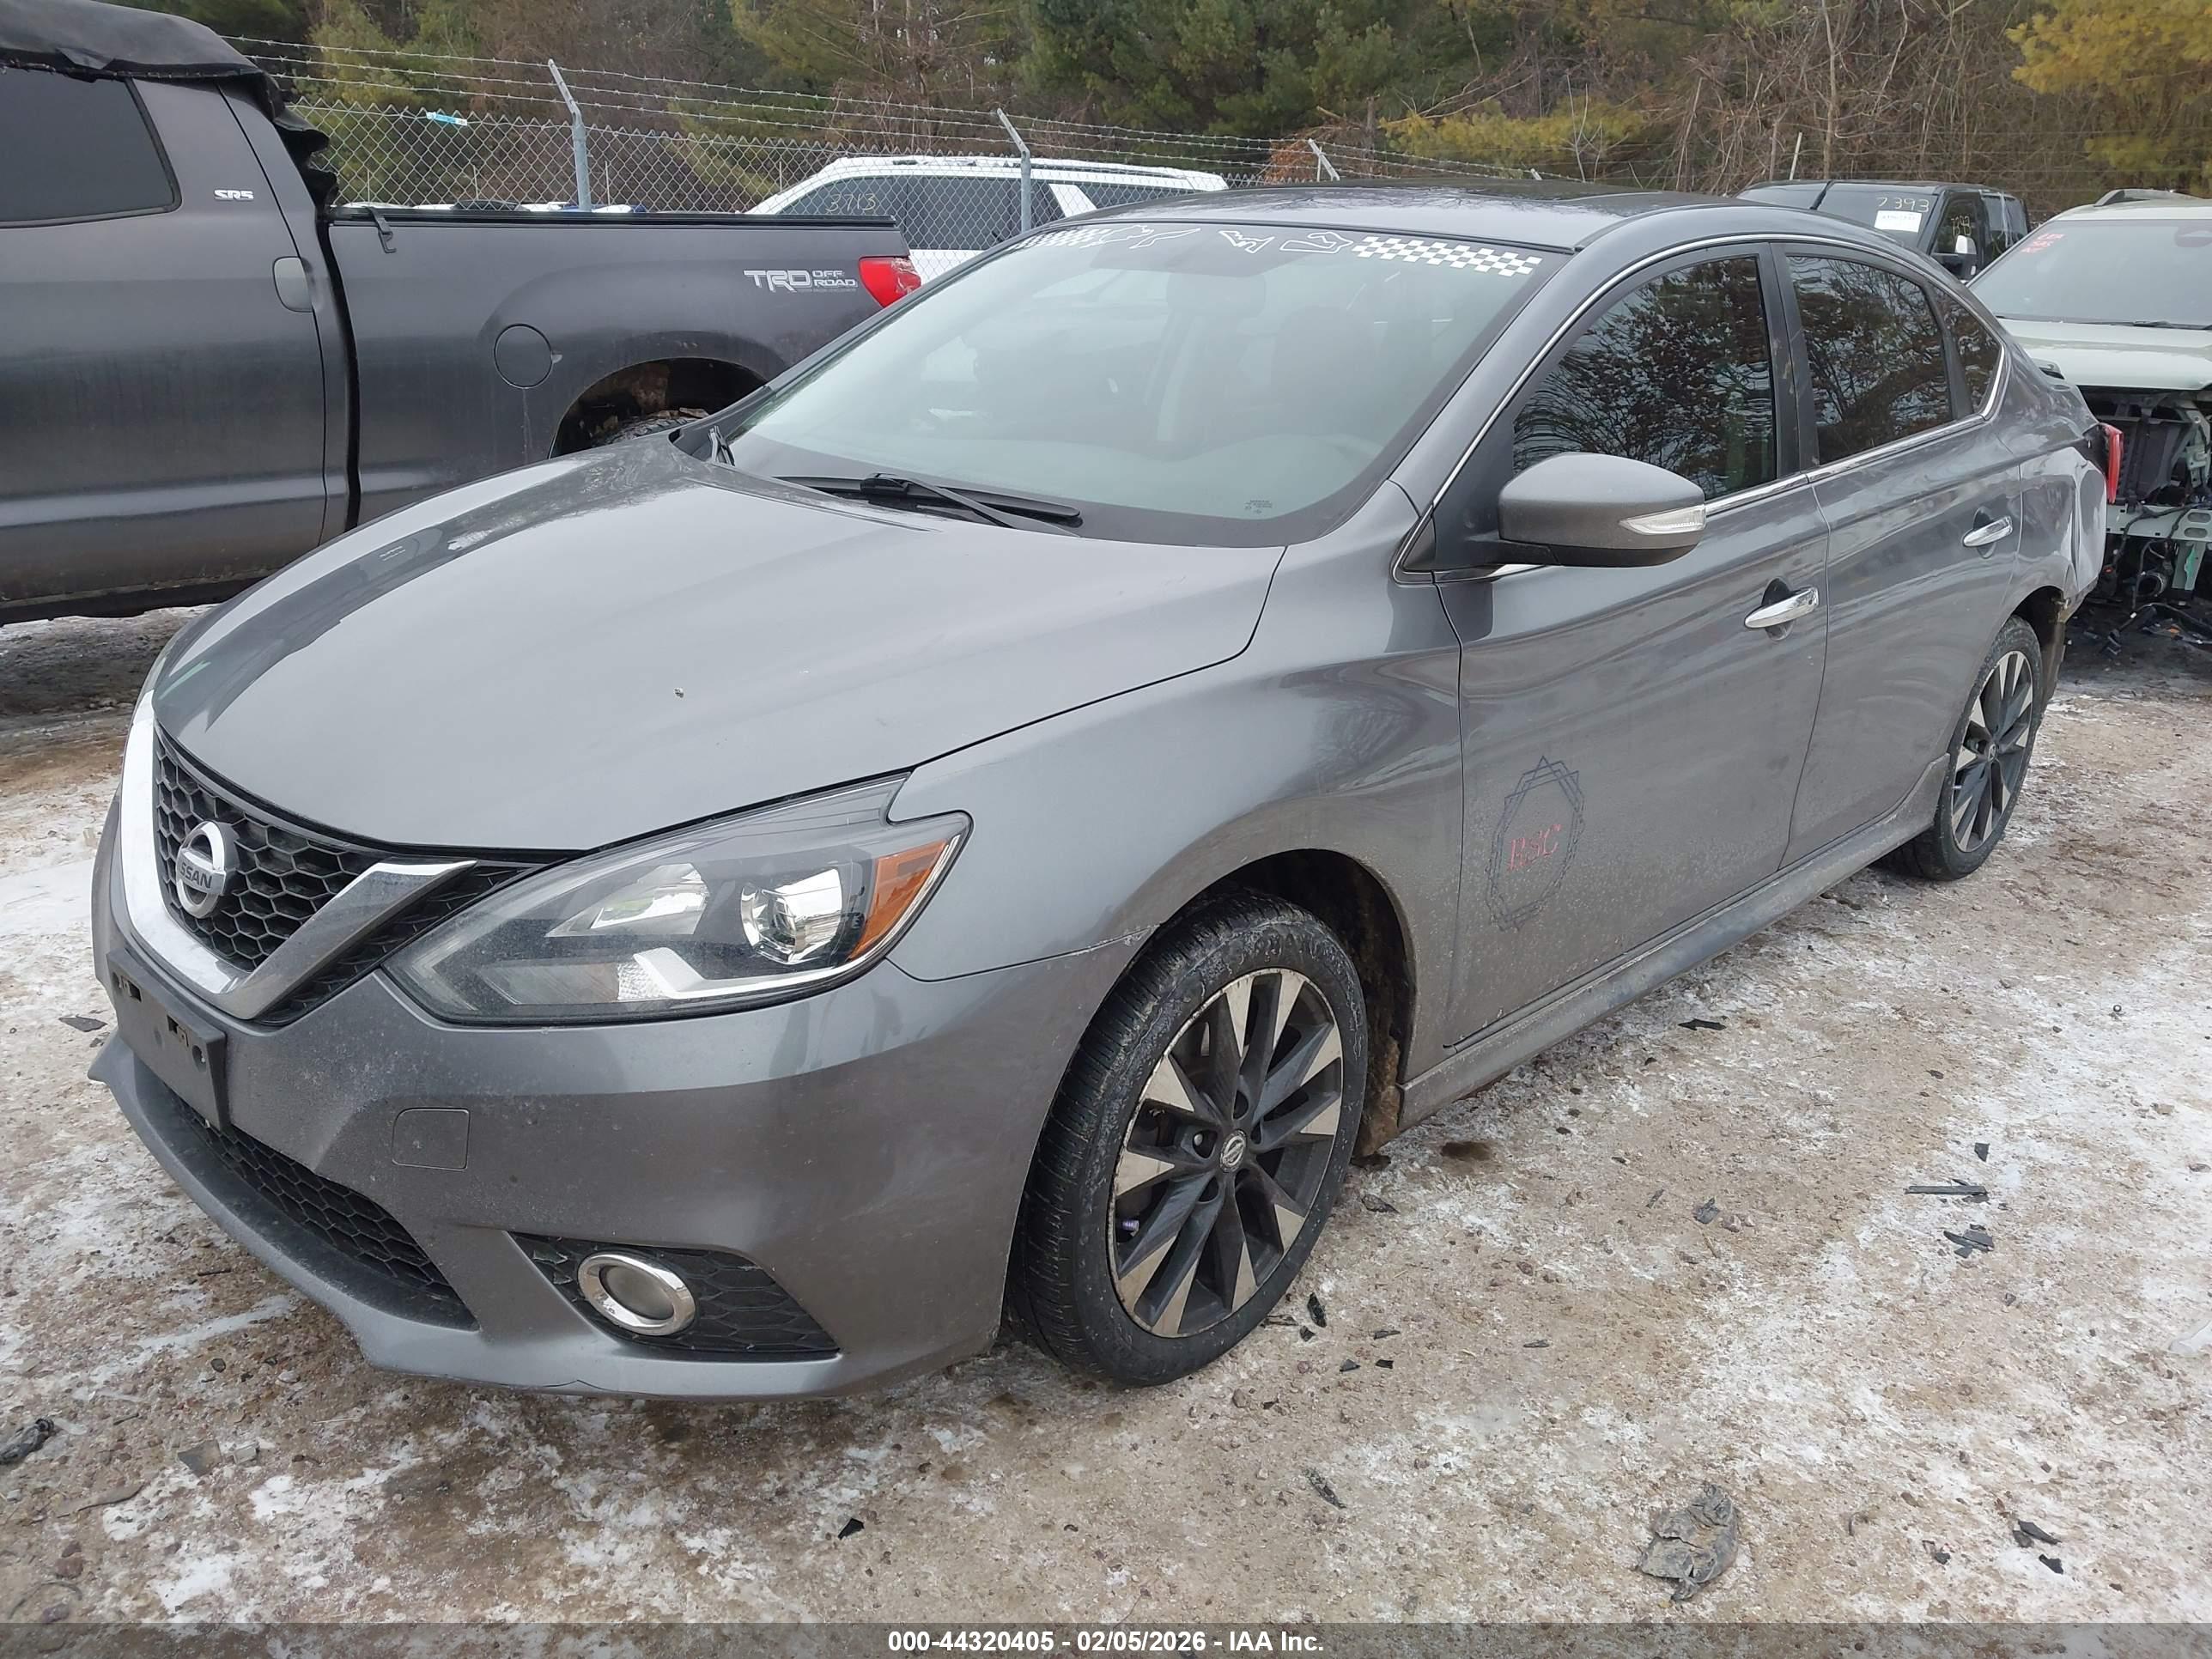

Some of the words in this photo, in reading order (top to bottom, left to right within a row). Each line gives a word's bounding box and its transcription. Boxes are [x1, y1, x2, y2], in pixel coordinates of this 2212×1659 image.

[824, 193, 876, 212] 3713
[1875, 197, 1929, 213] 7393
[743, 270, 812, 292] TRD
[811, 270, 844, 278] OFF
[812, 278, 859, 288] ROAD
[179, 860, 213, 889] SSAN
